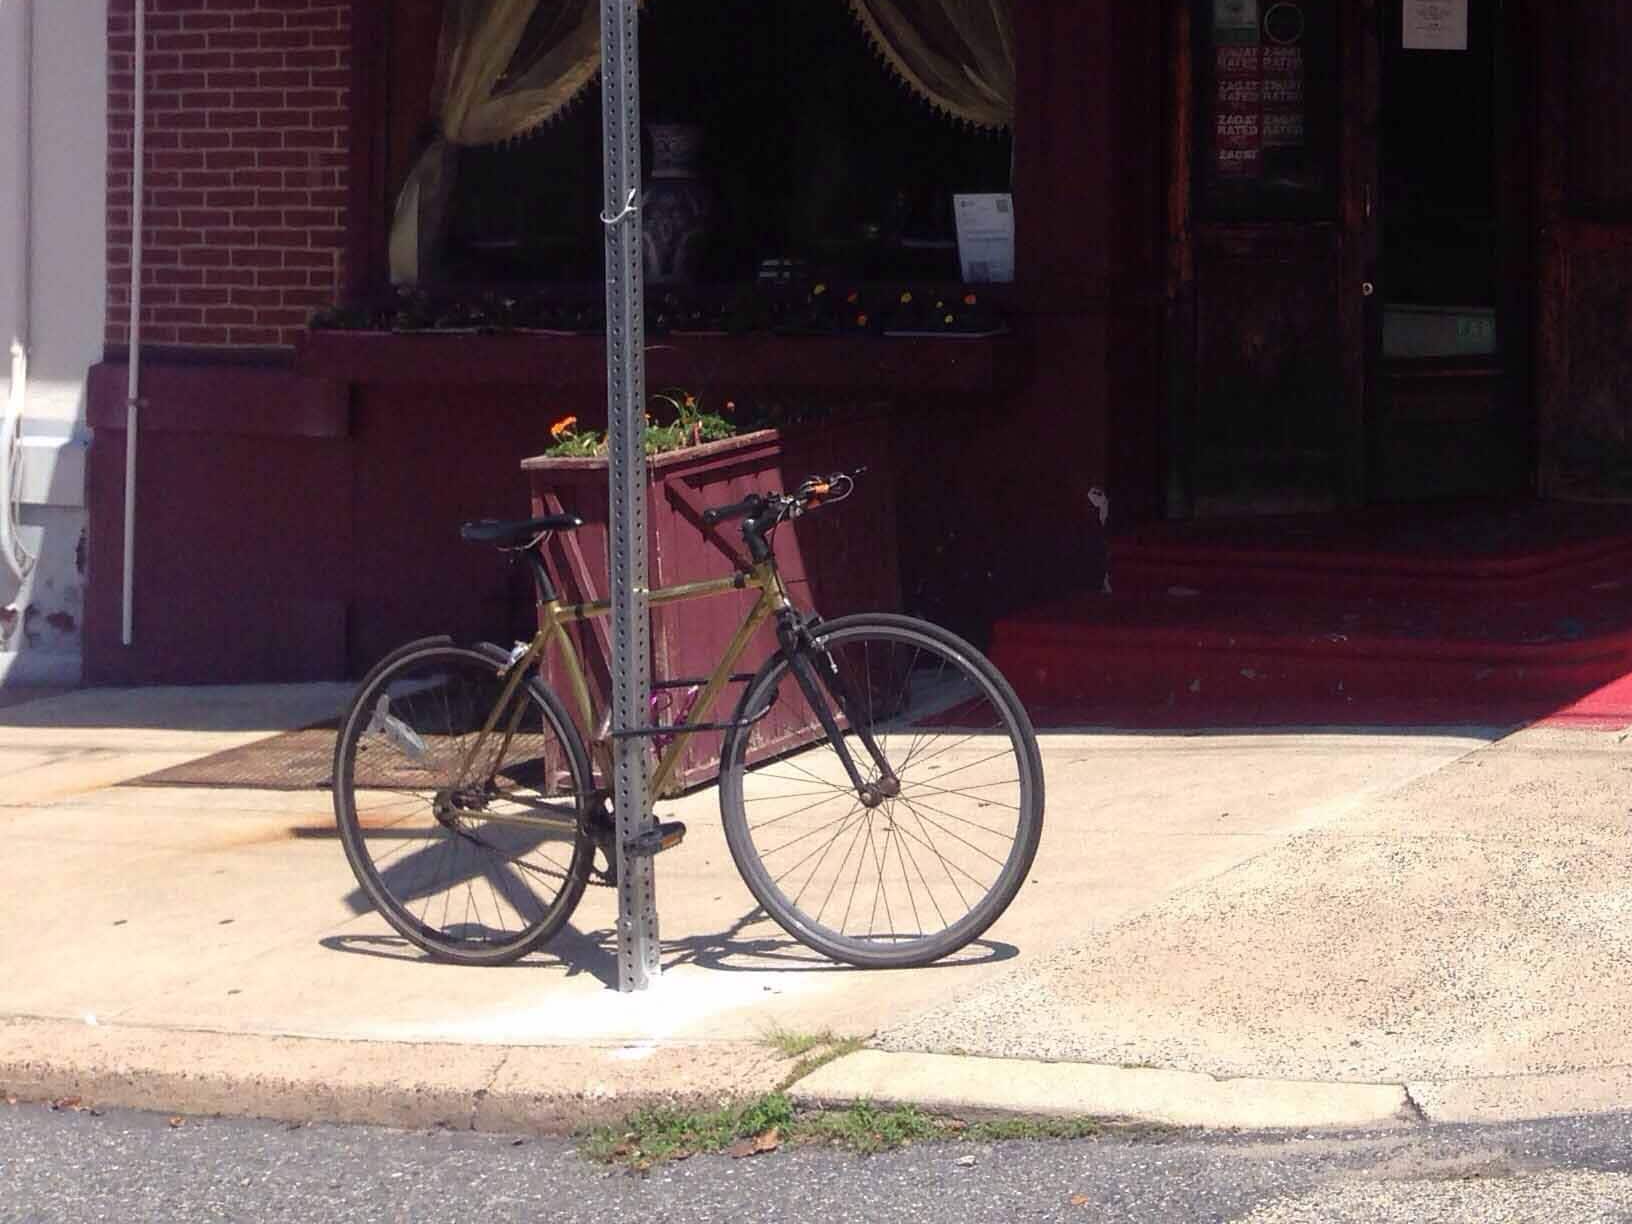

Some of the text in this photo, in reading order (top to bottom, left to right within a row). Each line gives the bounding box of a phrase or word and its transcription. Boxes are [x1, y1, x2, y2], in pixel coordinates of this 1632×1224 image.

[1217, 114, 1257, 125] ZAGAT
[1217, 126, 1258, 136] RATED
[1218, 150, 1258, 160] ZAGAT
